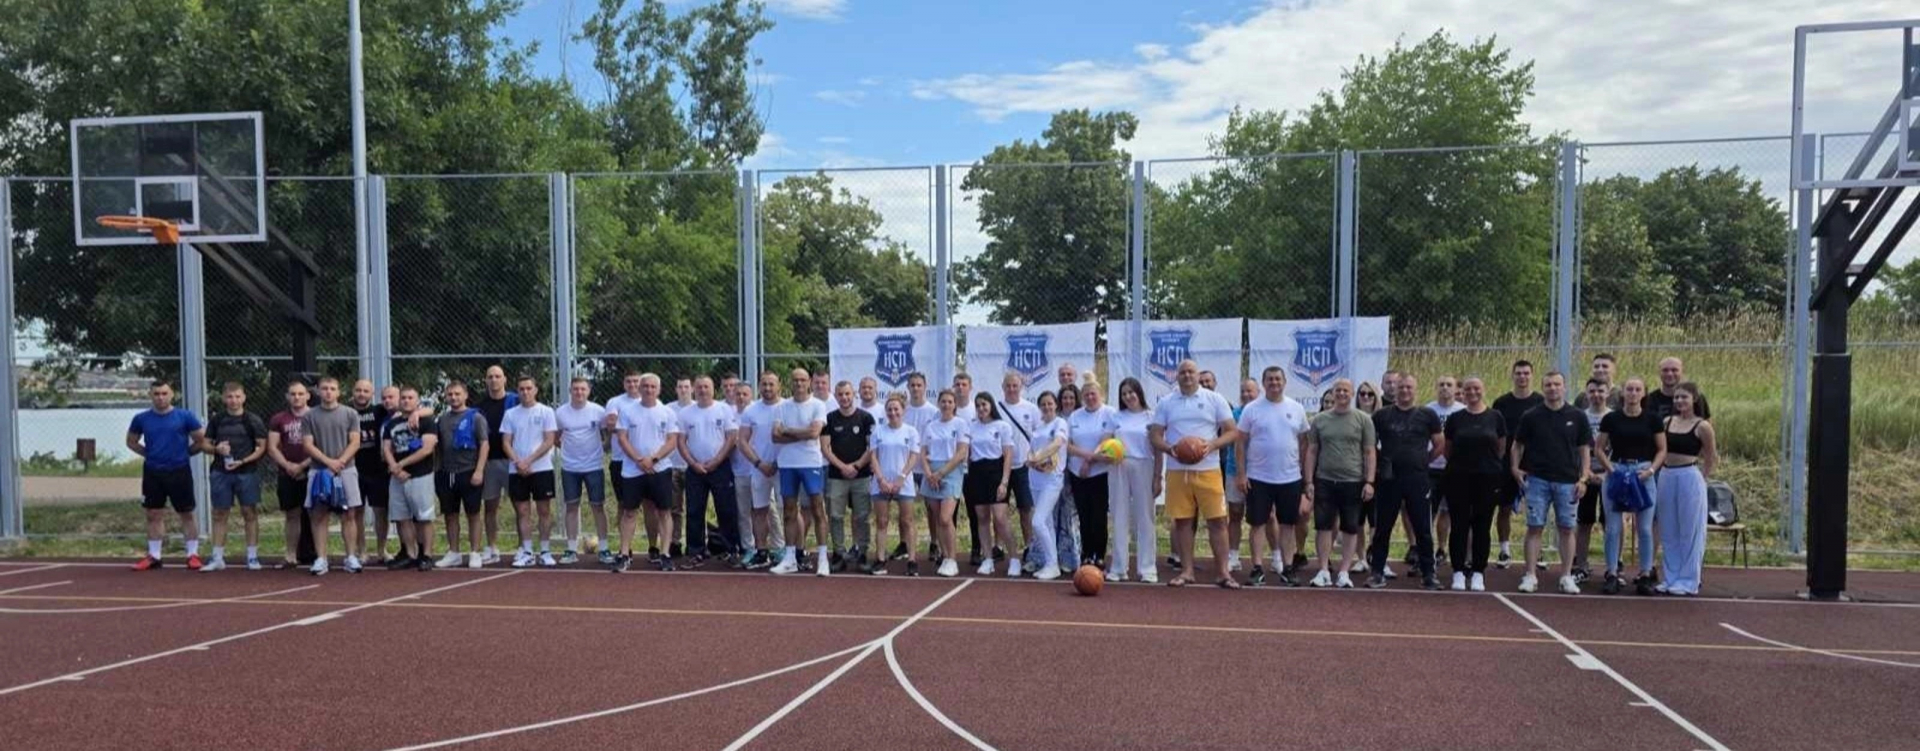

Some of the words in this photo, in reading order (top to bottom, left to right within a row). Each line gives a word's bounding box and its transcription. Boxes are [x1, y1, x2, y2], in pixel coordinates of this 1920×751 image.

[884, 350, 907, 369] НСП
[1014, 348, 1041, 369] НСП
[1157, 345, 1184, 365] НСП
[1302, 345, 1331, 367] НСП
